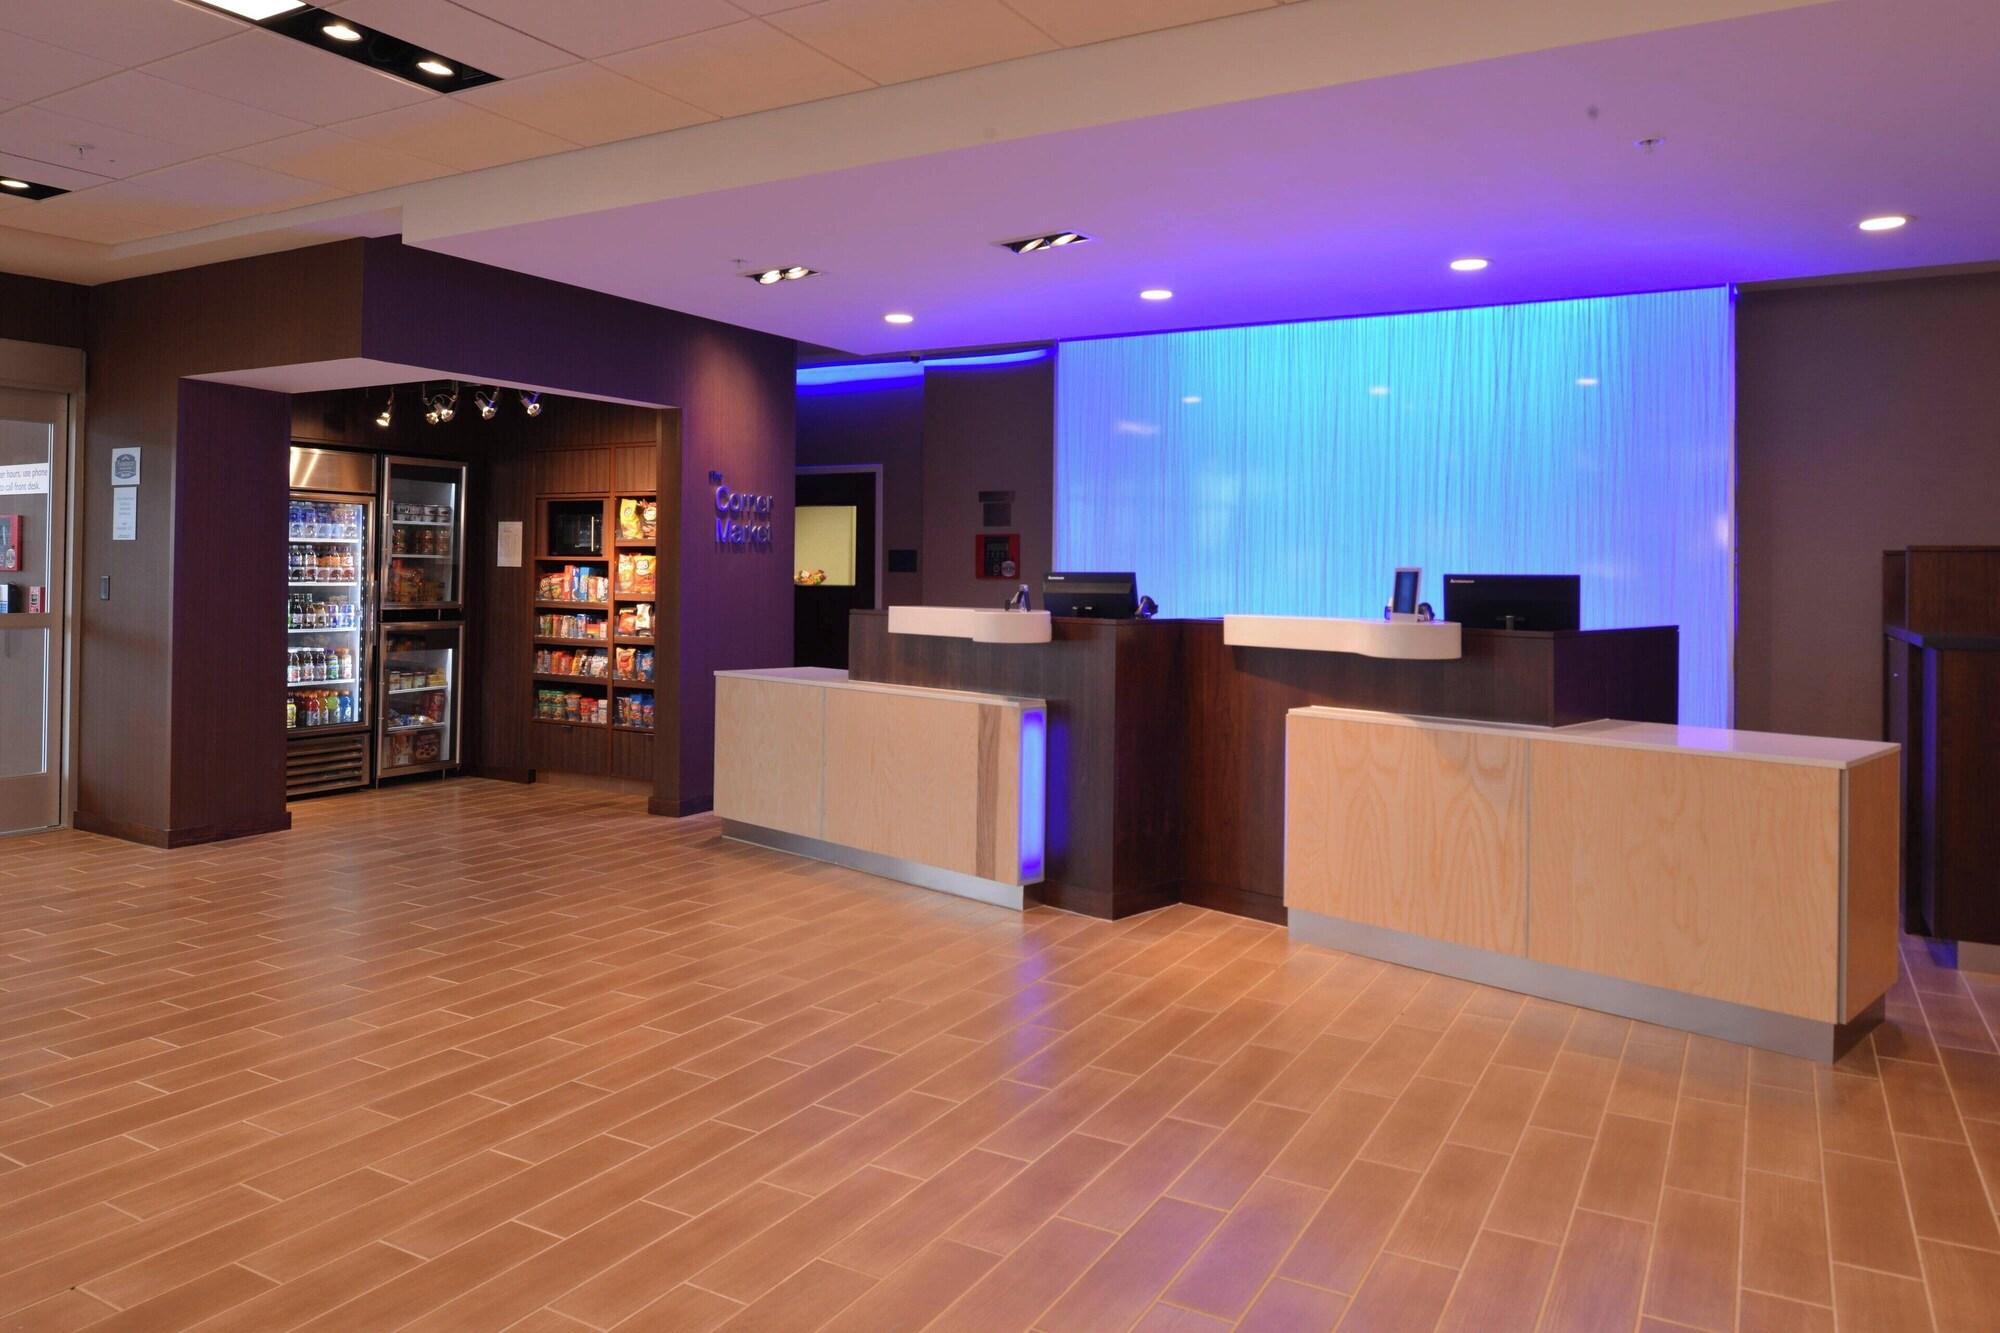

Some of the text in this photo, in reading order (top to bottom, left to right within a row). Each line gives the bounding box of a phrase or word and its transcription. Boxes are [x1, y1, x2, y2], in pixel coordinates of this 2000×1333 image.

[32, 468, 48, 479] phone
[15, 481, 26, 490] front
[715, 486, 774, 513] Corner
[715, 517, 773, 545] Market
